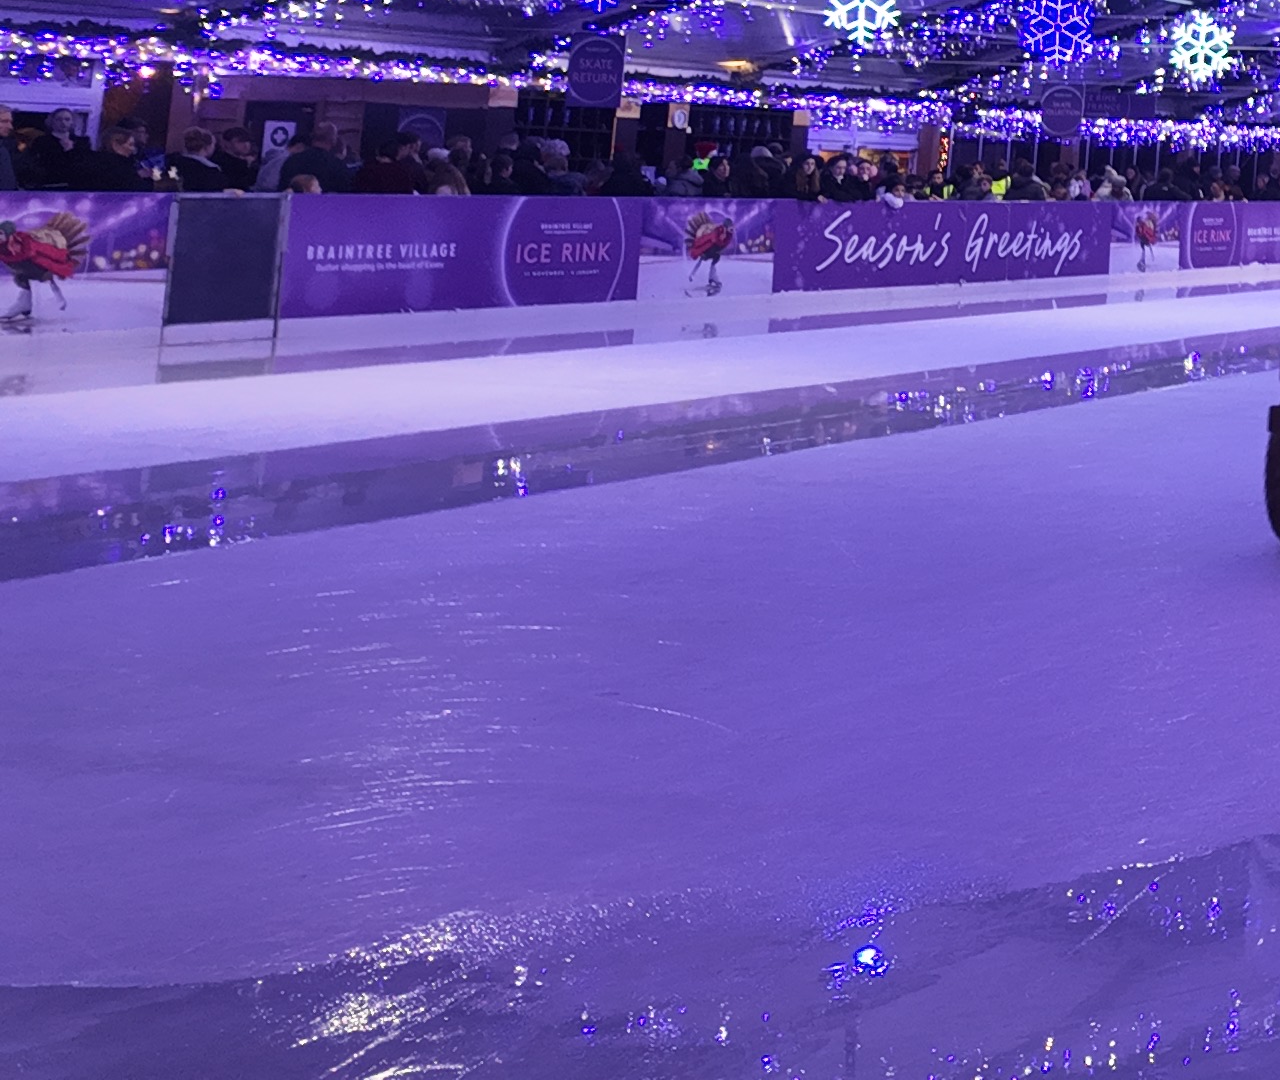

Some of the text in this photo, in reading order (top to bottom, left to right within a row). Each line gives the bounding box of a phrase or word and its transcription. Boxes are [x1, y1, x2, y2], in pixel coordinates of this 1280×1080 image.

[579, 57, 613, 70] SKATE
[572, 71, 618, 85] RETURN
[815, 210, 1083, 275] Season's Greetings
[1193, 229, 1208, 244] ICE
[1210, 229, 1232, 243] RINK
[306, 242, 457, 260] BRAINTREE VILLAGE
[515, 241, 611, 264] ICE RINK
